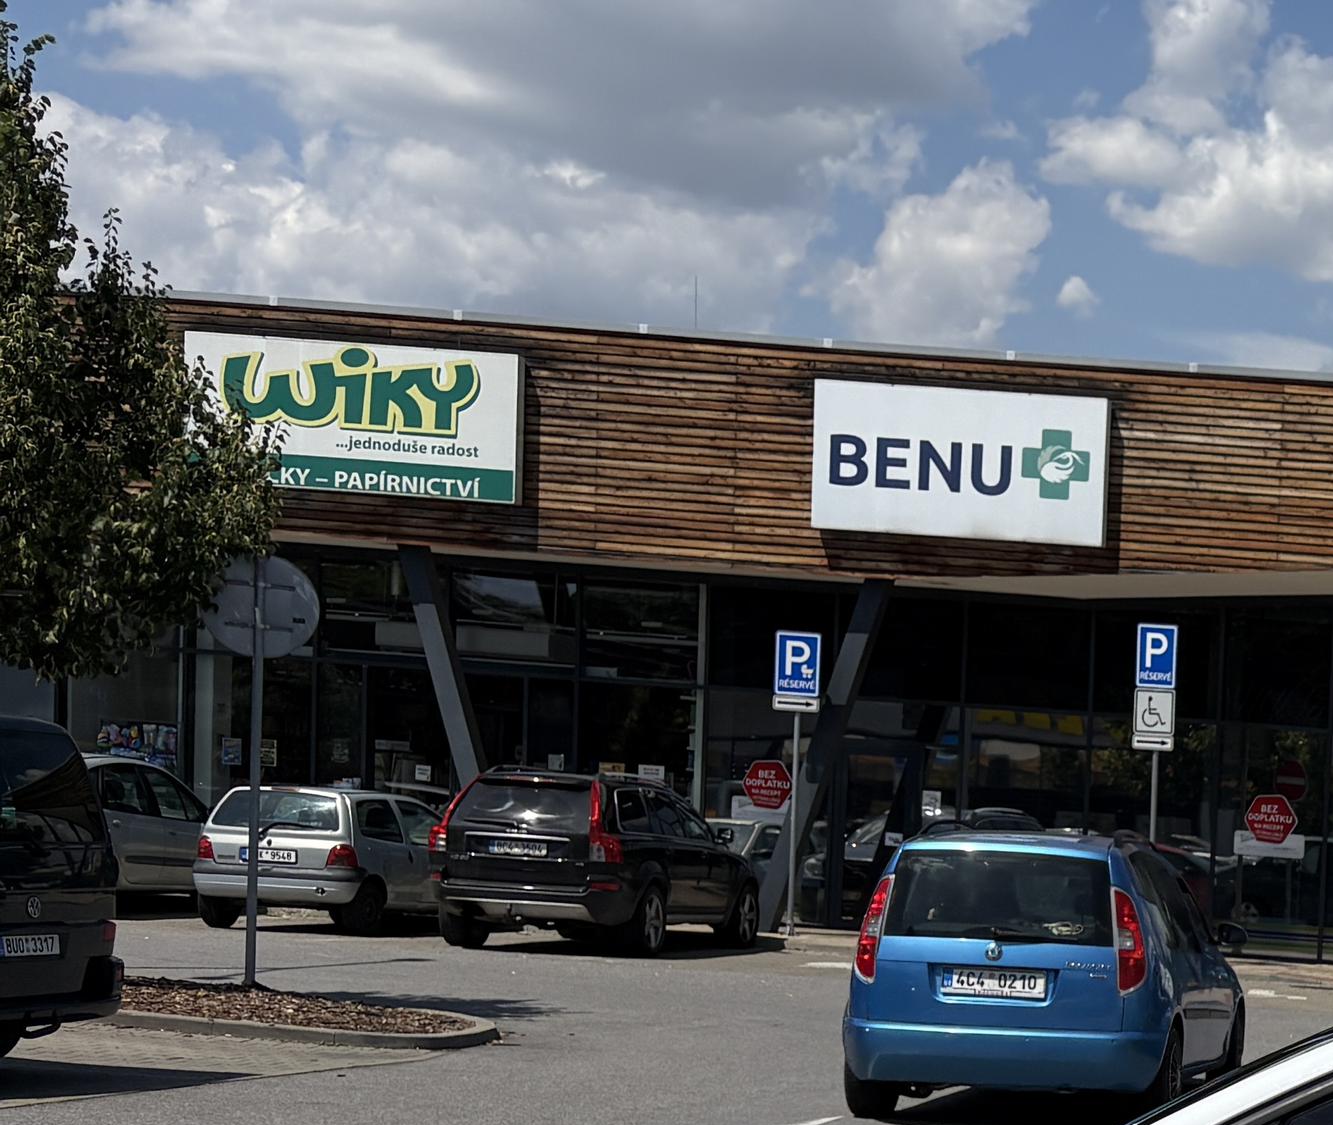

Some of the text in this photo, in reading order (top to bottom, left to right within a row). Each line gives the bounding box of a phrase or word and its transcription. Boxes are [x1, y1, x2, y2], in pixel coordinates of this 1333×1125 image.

[430, 440, 479, 458] radost
[828, 433, 1014, 497] BENU
[334, 470, 481, 499] PAPÍRNICTVÍ
[784, 639, 811, 676] P
[1145, 632, 1169, 668] P
[745, 778, 790, 790] DOPLATKU
[758, 769, 776, 779] BEZ
[1261, 804, 1279, 814] BEZ
[956, 971, 1037, 991] 4C4 0210
